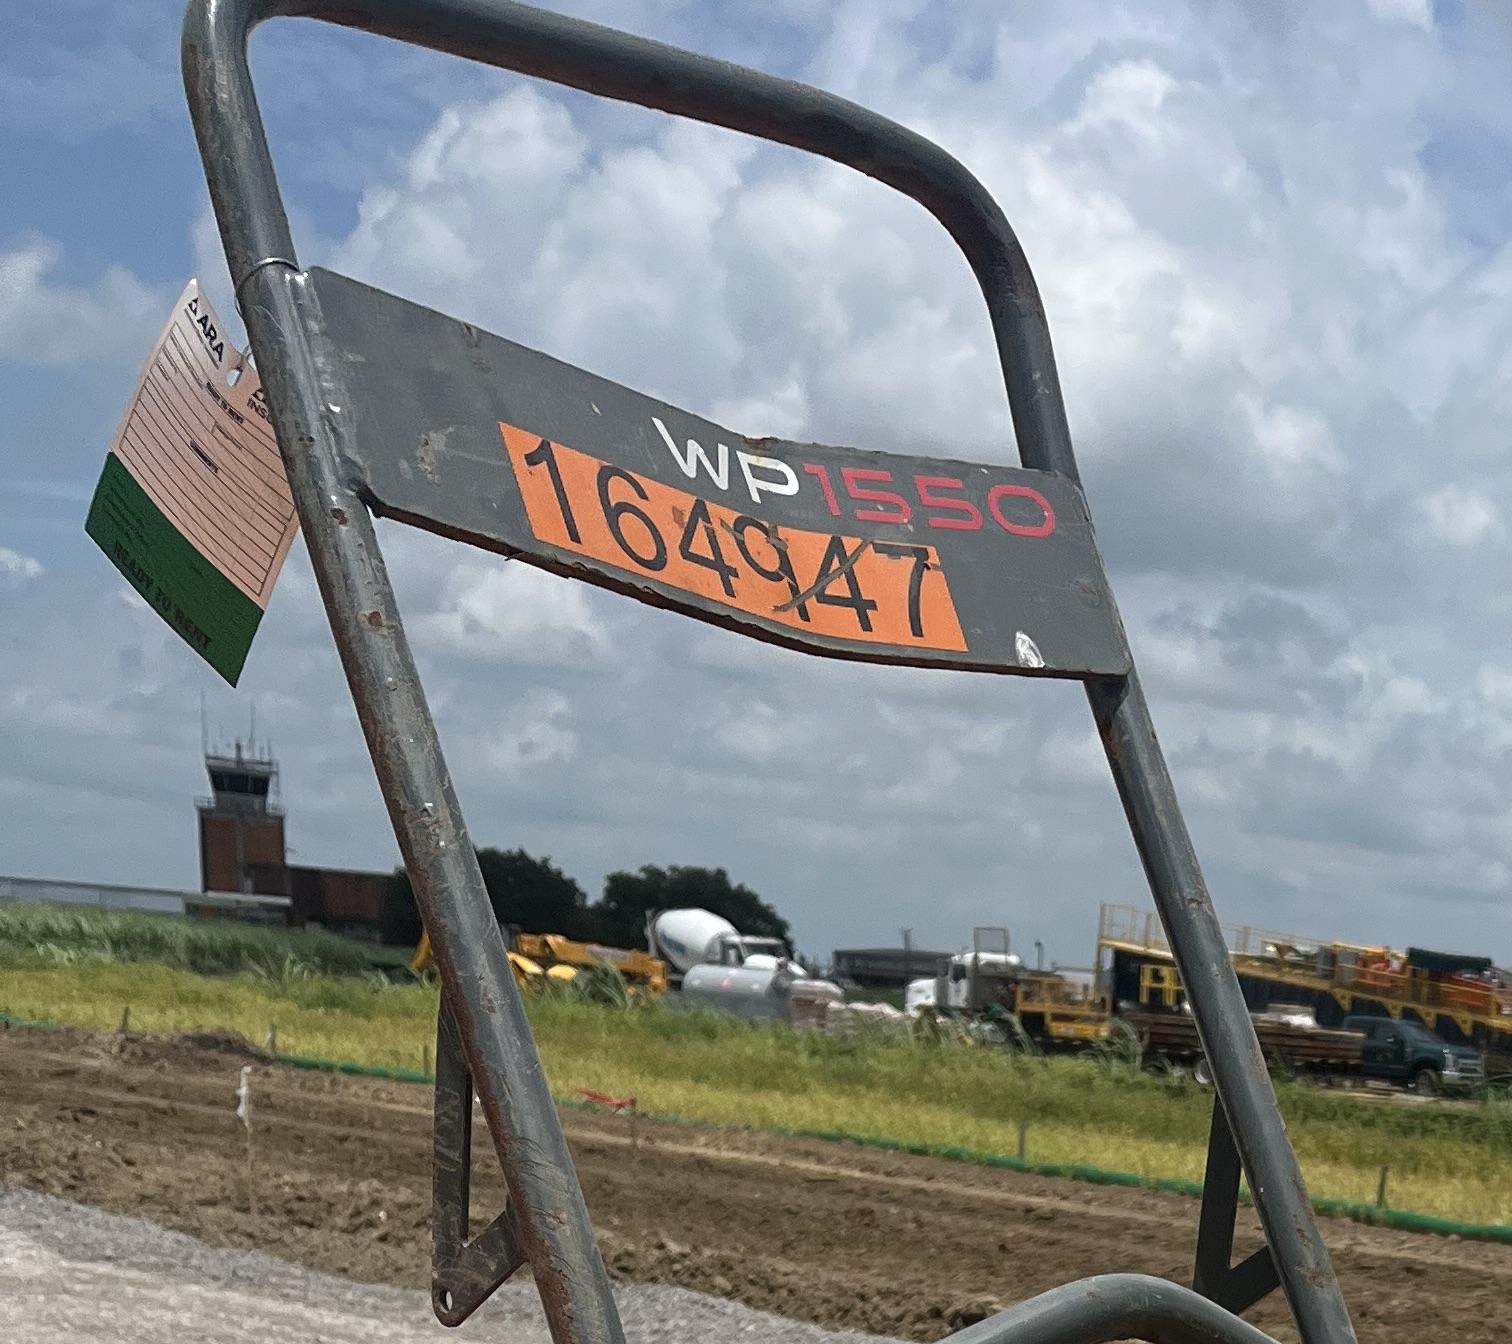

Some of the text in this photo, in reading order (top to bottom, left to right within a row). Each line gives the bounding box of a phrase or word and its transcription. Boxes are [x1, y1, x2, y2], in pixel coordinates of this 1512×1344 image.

[197, 314, 224, 362] ARA
[651, 416, 1057, 538] WP1550
[525, 439, 931, 638] 164947
